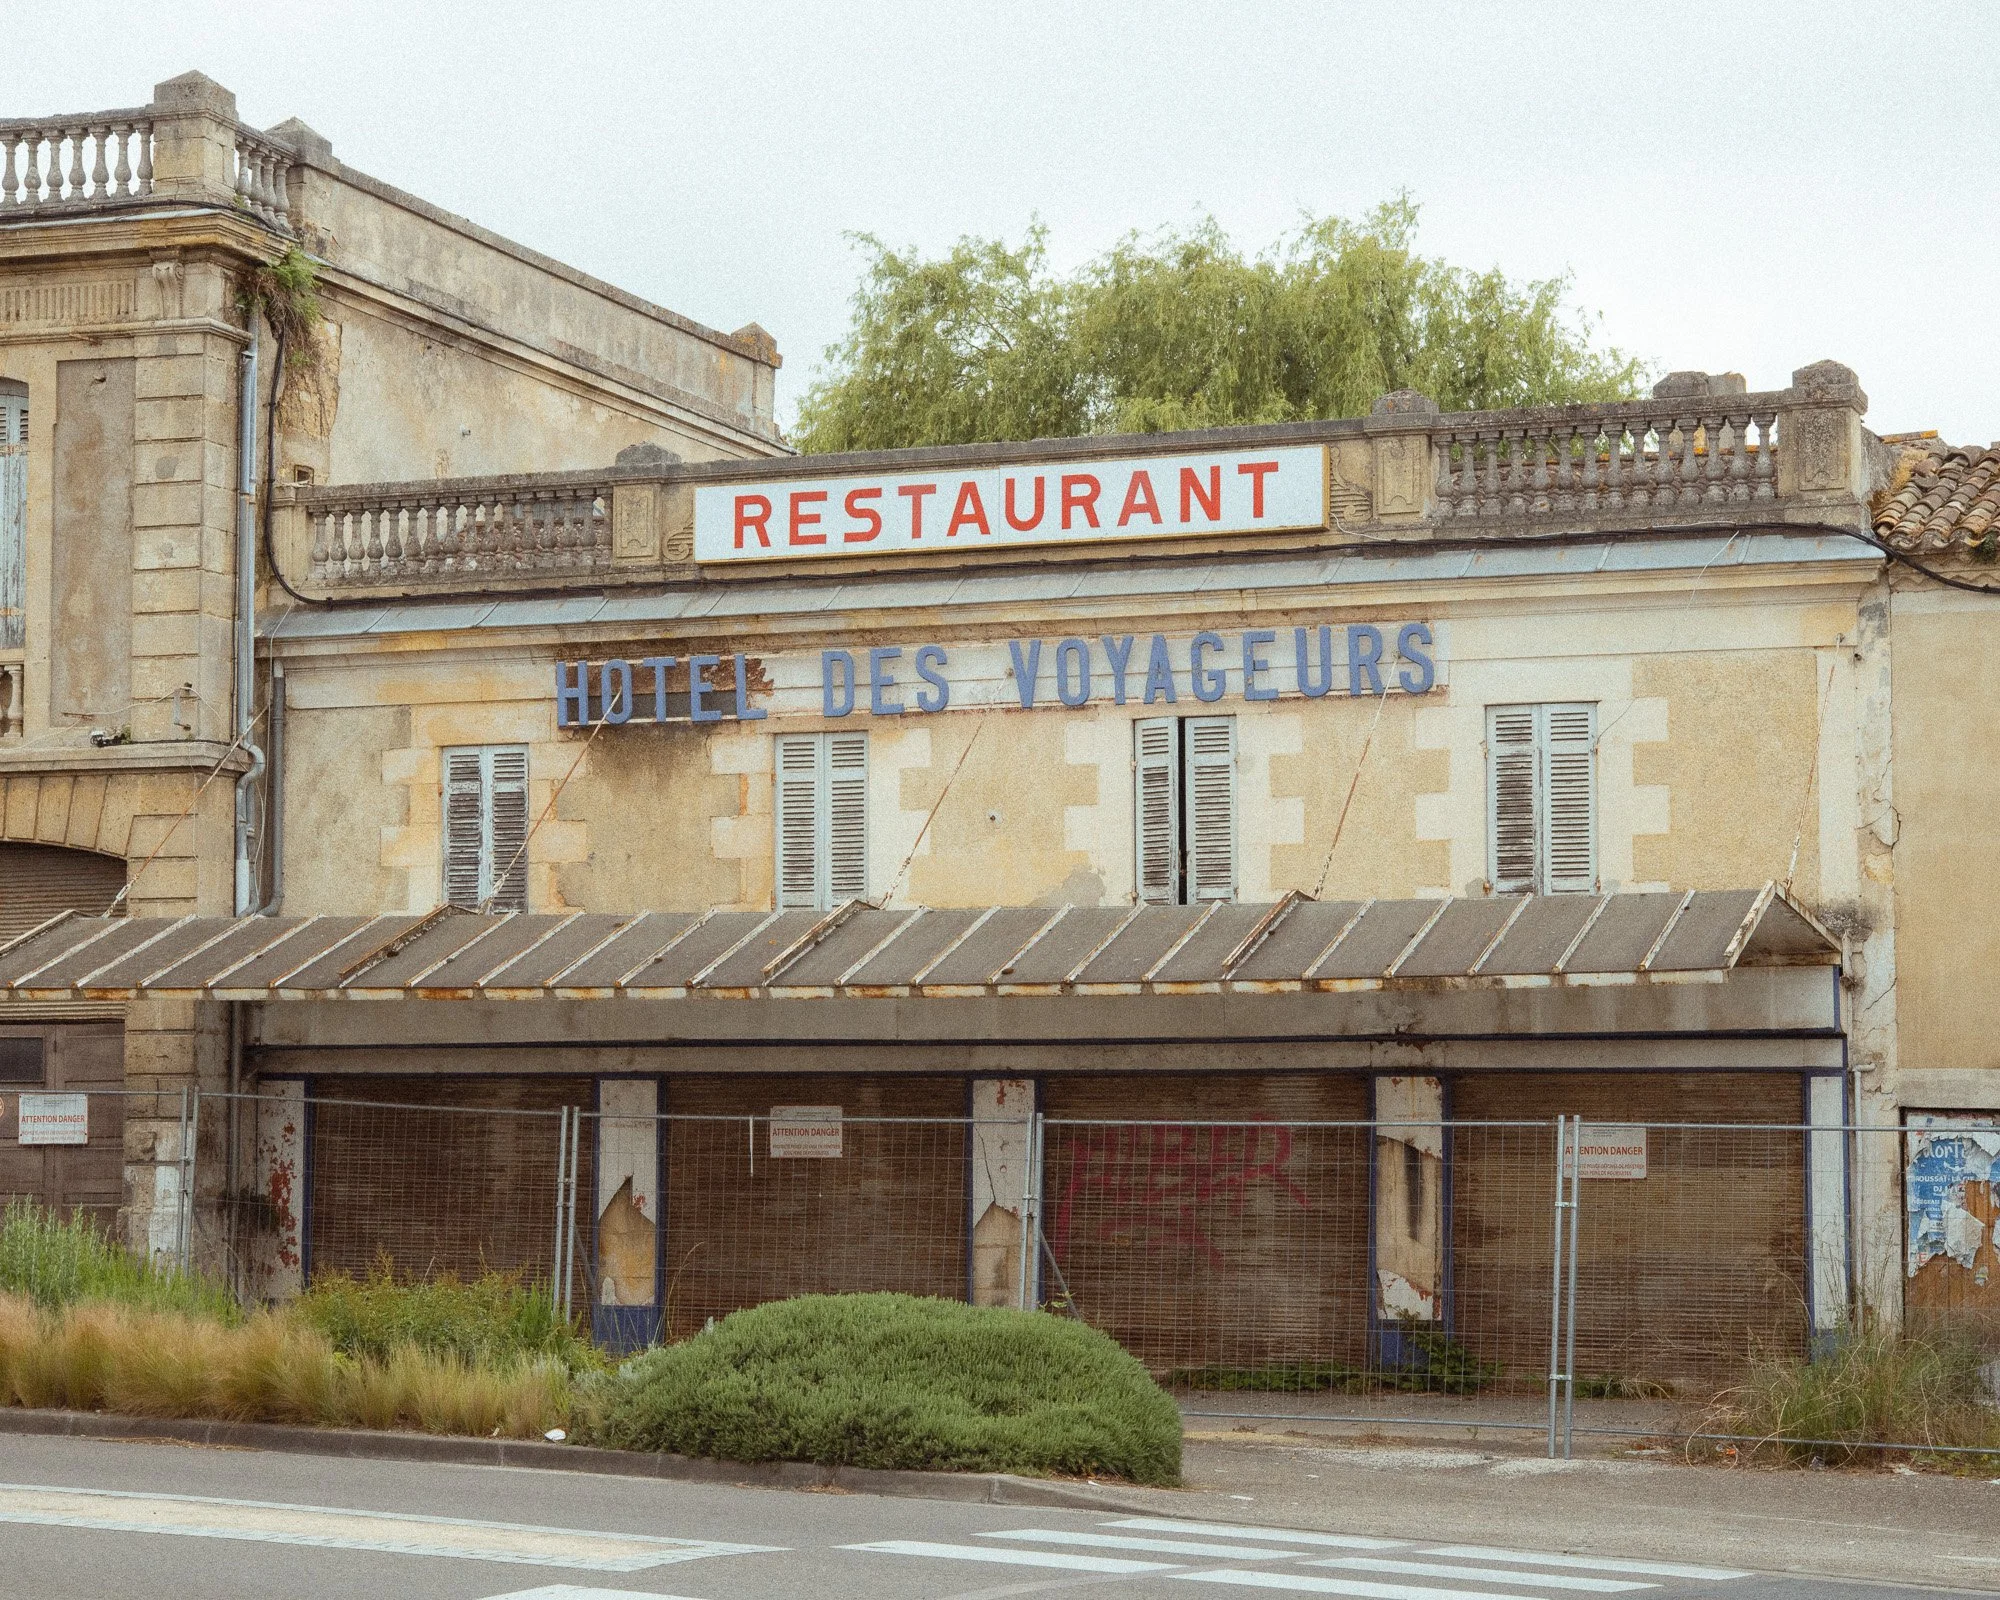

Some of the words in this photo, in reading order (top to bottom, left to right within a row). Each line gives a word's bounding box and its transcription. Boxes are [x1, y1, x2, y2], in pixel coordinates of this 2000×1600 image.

[733, 461, 1280, 550] RESTAURANT
[556, 653, 768, 727] HOTEL
[821, 645, 951, 718] DES
[1009, 622, 1435, 710] VOYAGEURS
[22, 1115, 58, 1123] ATTENTION
[59, 1115, 85, 1123] DANGER
[773, 1128, 809, 1136] ATTENTION
[811, 1128, 839, 1136] DANGER
[1565, 1146, 1609, 1156] ATENTION
[1610, 1146, 1643, 1156] DANGER
